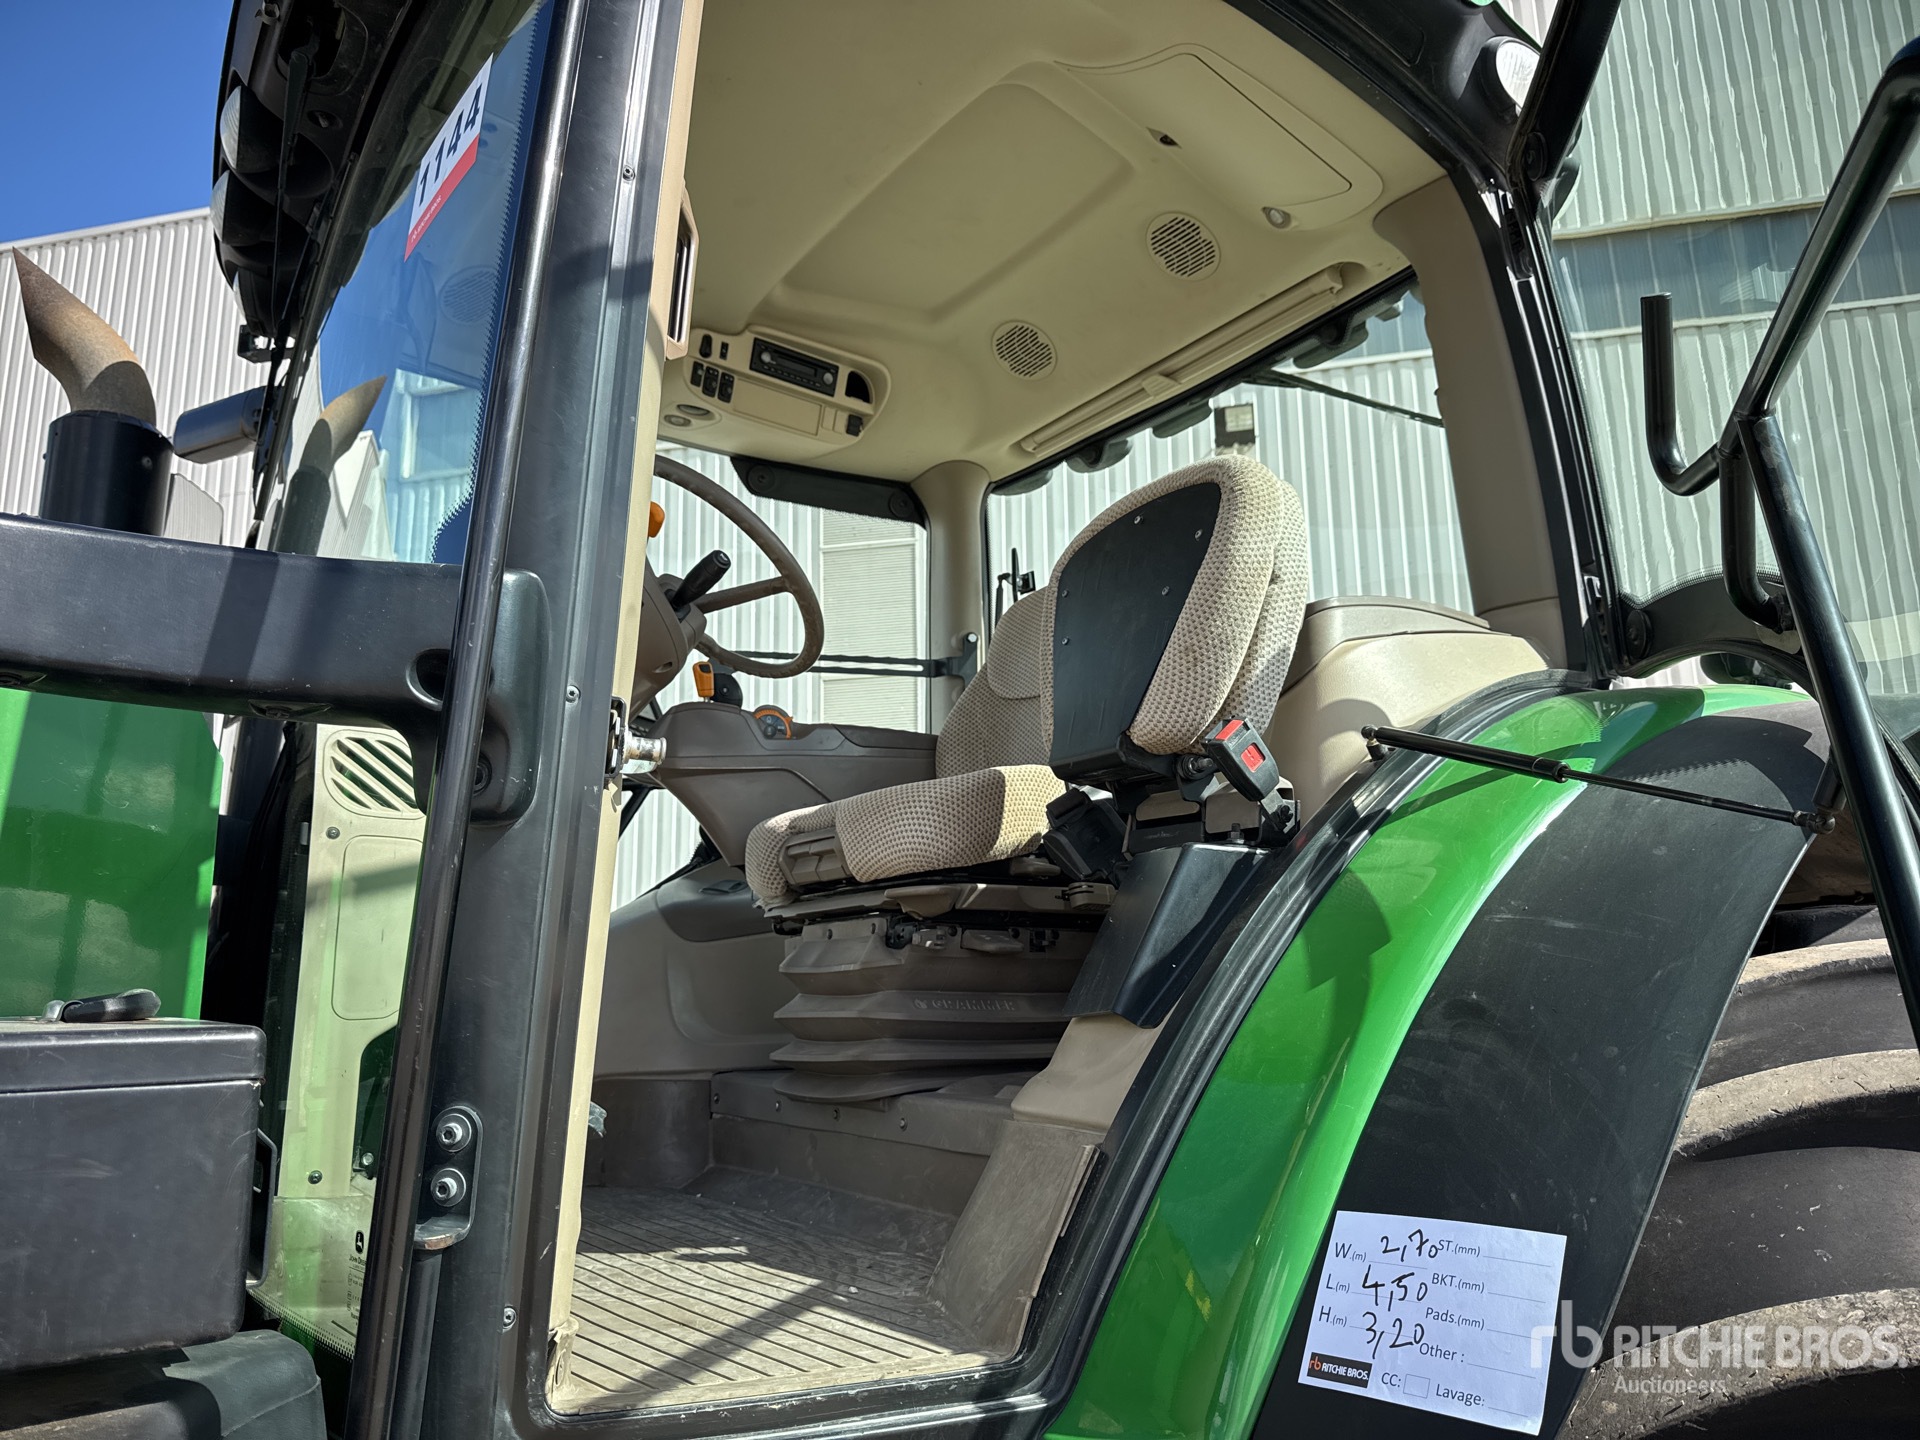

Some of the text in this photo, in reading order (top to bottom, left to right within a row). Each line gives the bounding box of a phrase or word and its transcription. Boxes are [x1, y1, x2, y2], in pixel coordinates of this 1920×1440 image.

[418, 83, 482, 207] 1144
[1437, 1239, 1481, 1257] ST.(mm)
[1362, 1264, 1428, 1312] 4,50
[1431, 1272, 1485, 1294] BKT.(mm)
[1425, 1307, 1485, 1330] Pads.(mm)
[1362, 1311, 1425, 1359] 3,20
[1309, 1356, 1369, 1380] rb RITCHIE BROS.
[1381, 1372, 1485, 1407] CC: Lavage:
